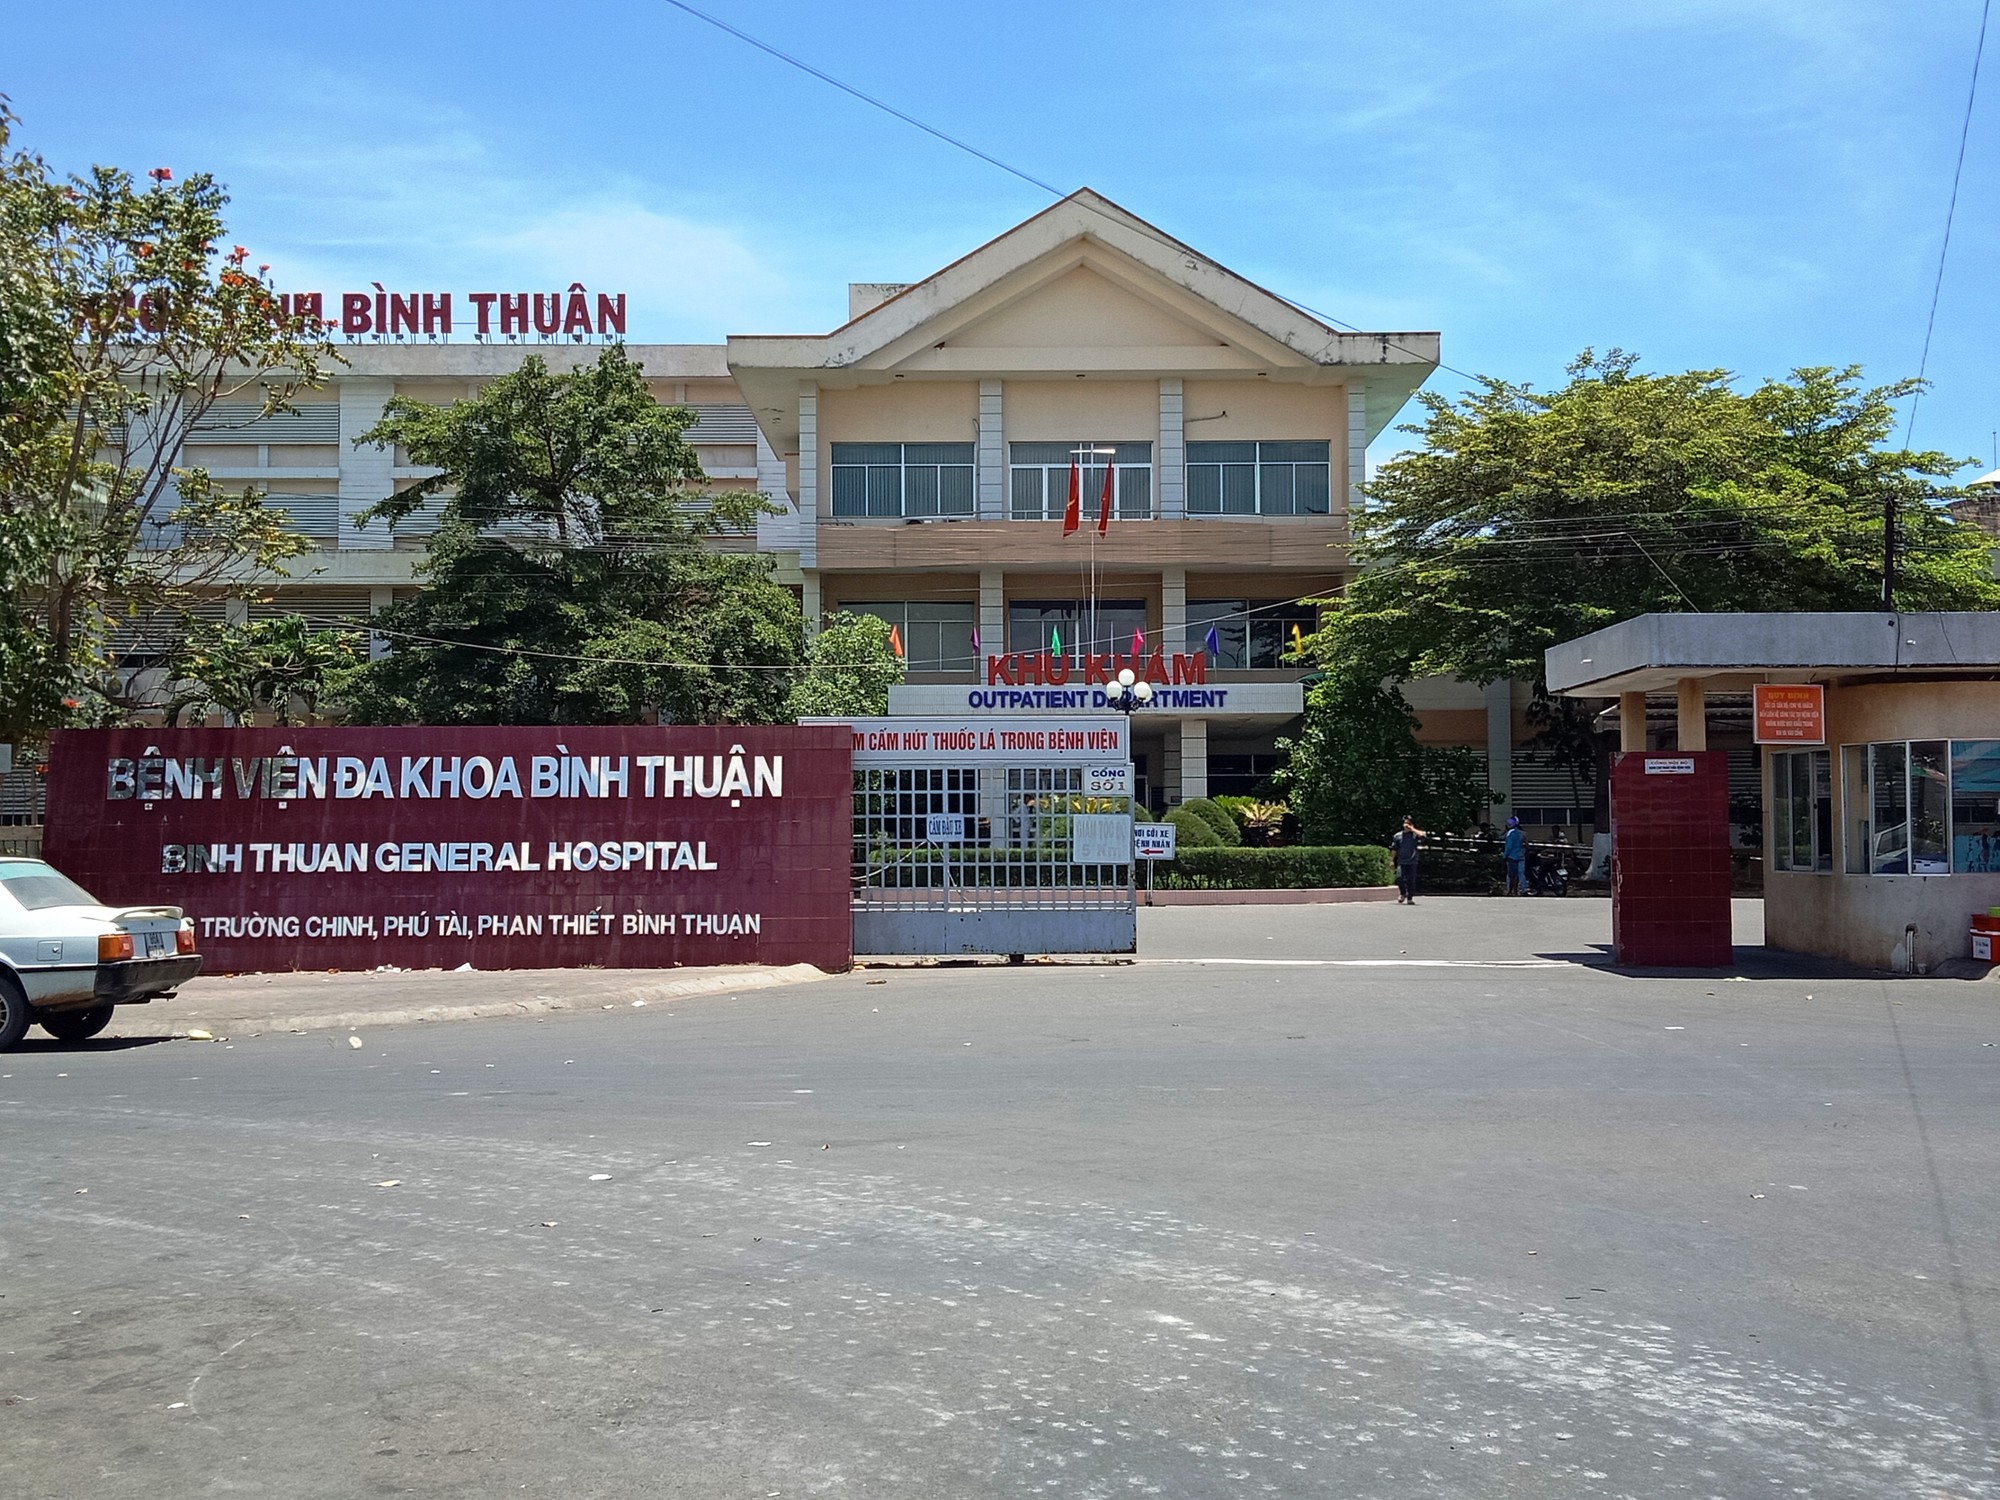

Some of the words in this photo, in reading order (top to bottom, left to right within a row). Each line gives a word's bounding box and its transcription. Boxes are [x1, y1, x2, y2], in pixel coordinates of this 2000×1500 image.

[342, 282, 451, 334] BÌNH
[988, 652, 1070, 686] KHU
[1084, 644, 1206, 686] KHÁM
[968, 690, 1088, 708] OUTPATIENT
[868, 727, 899, 751] CẤM
[903, 728, 928, 751] HÚT
[932, 726, 976, 750] THUỐC
[979, 727, 996, 750] LÁ
[1000, 732, 1044, 750] TRONG
[1048, 728, 1084, 753] BỆNH
[1087, 728, 1118, 753] VIỆN
[107, 745, 224, 810] BỆNH
[232, 745, 327, 810] VIỆN
[333, 757, 394, 799] ĐA
[401, 756, 523, 799] KHOA
[531, 744, 628, 798] BÌNH
[637, 744, 783, 808] THUẬN
[162, 843, 243, 873] BINH
[250, 842, 369, 873] THUAN
[375, 842, 540, 872] GENERAL
[548, 841, 718, 871] HOSPITAL
[200, 911, 300, 938] TRƯỜNG
[305, 915, 378, 940] CHINH,
[383, 911, 430, 937] PHÚ
[435, 910, 473, 939] TÀI,
[478, 914, 543, 936] PHAN
[548, 906, 615, 935] THIẾT
[622, 909, 676, 935] BÌNH
